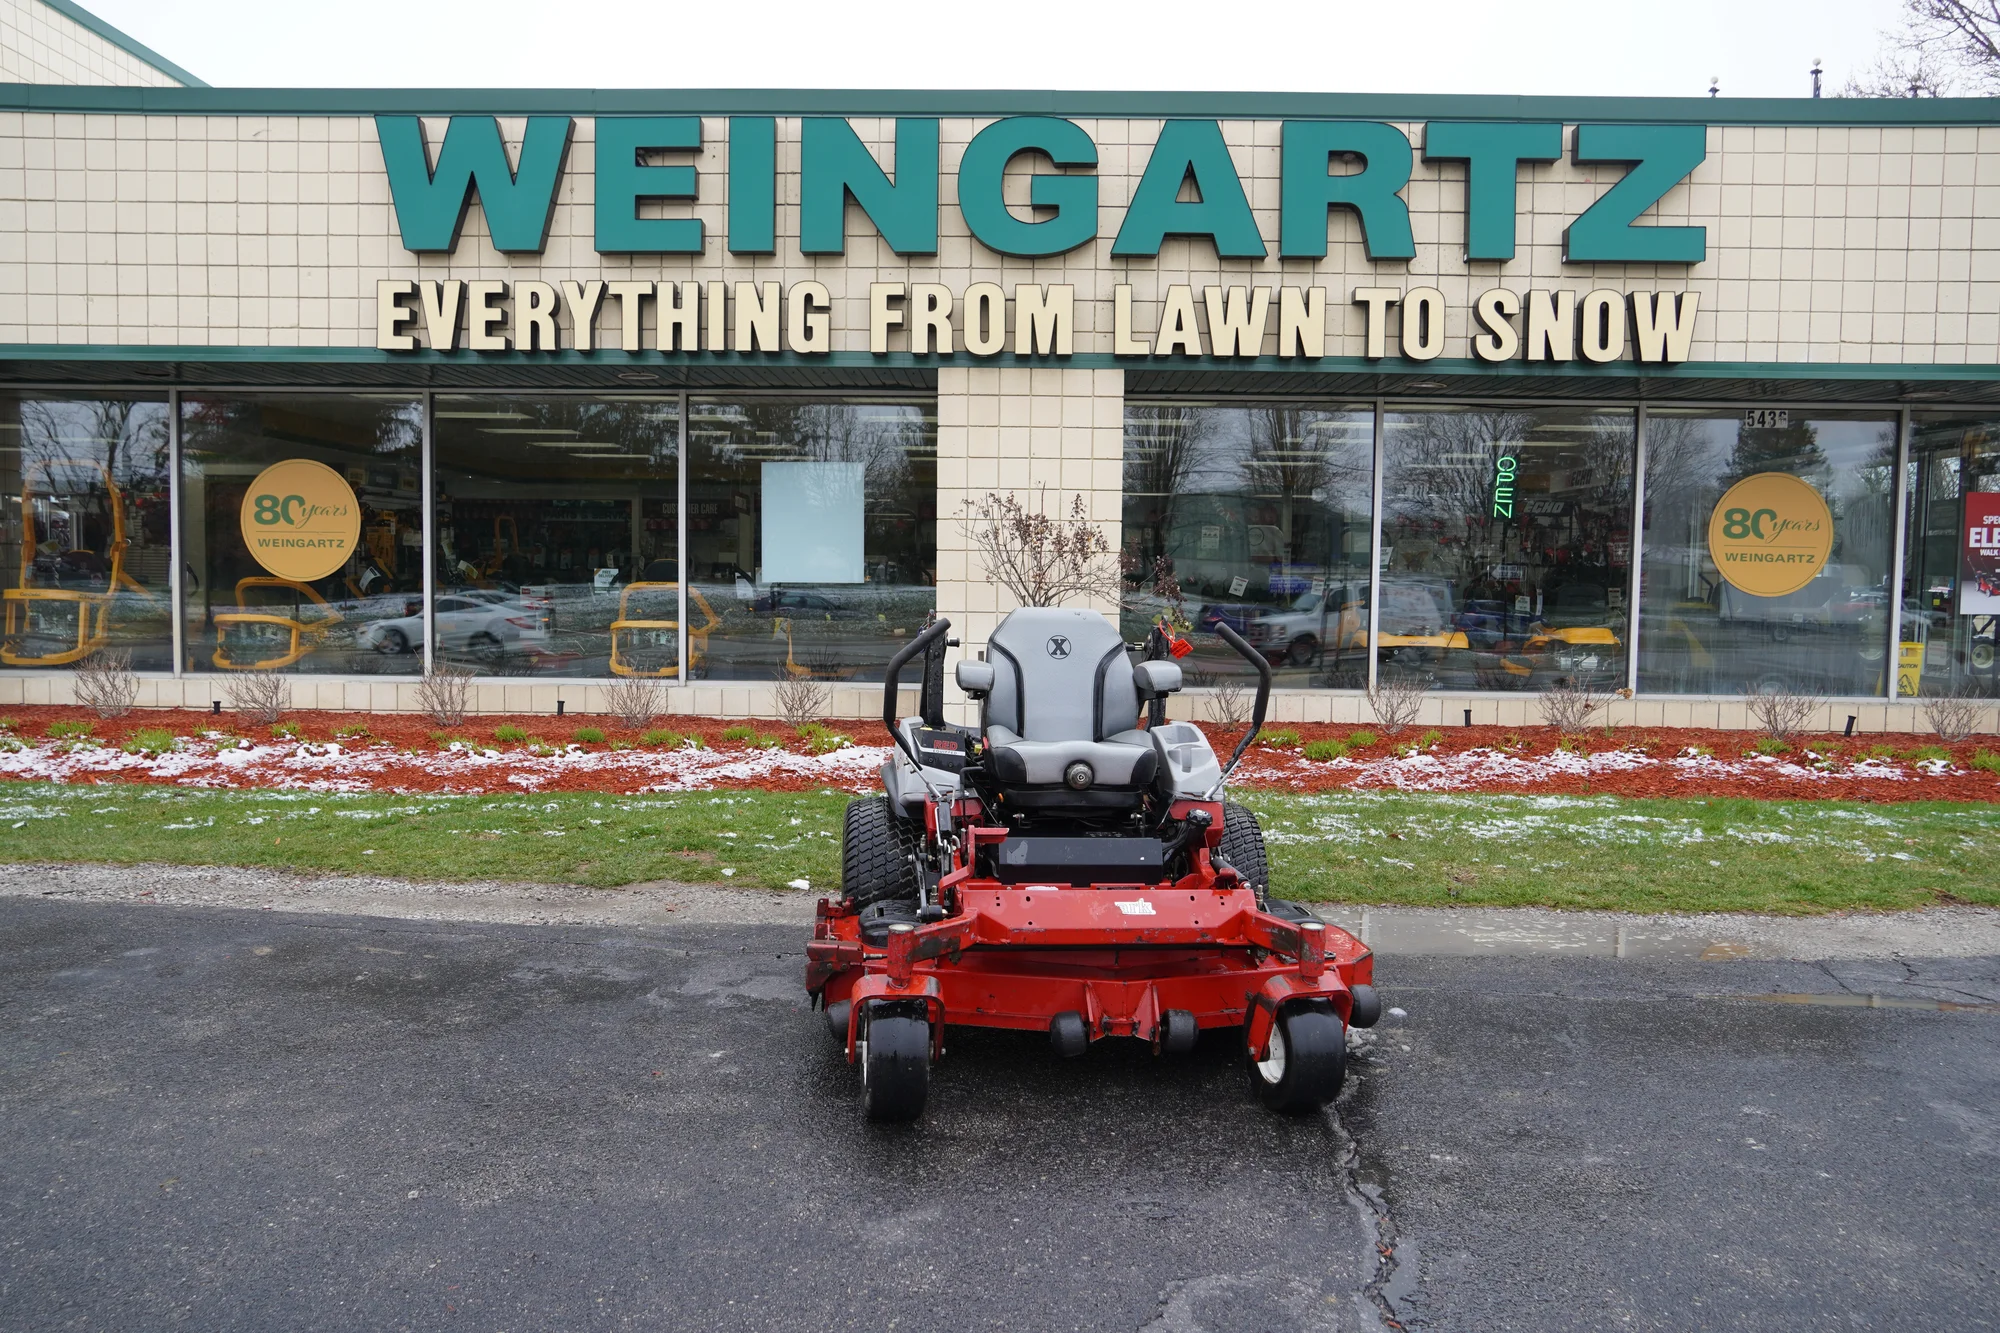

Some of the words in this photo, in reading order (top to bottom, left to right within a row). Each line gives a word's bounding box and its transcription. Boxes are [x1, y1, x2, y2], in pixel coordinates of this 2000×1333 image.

[374, 115, 1706, 264] WEINGARTZ
[377, 280, 831, 354] EVERYTHING
[869, 282, 1074, 357] FROM
[1114, 284, 1327, 360] LAWN
[1352, 286, 1446, 361] TO
[1473, 288, 1701, 363] SNOW
[1571, 469, 1593, 486] ECHO
[1493, 456, 1516, 518] OPEN
[254, 494, 306, 525] 80
[295, 504, 348, 529] years
[700, 503, 718, 514] CARE
[1523, 501, 1565, 514] ECHO
[1722, 507, 1777, 540] 80
[1765, 519, 1820, 544] years
[257, 538, 345, 548] WEINGARTZ
[1724, 552, 1815, 564] WEINGARTZ
[933, 739, 958, 751] RED
